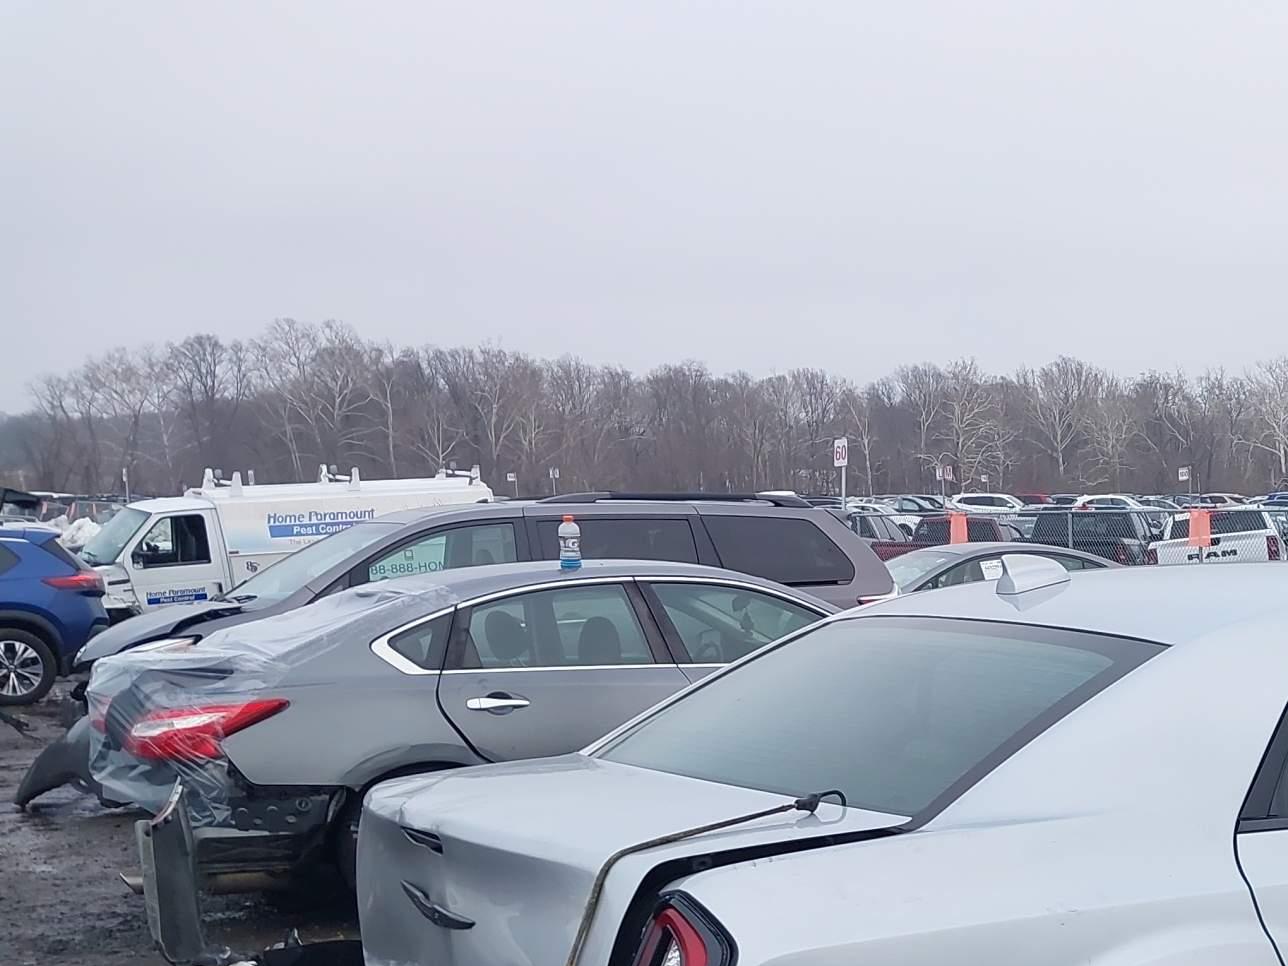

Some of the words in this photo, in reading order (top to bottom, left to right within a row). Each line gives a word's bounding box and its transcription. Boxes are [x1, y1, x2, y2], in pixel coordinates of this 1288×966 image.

[835, 445, 846, 461] 60
[267, 512, 305, 524] Home
[308, 508, 375, 523] Paramount
[293, 525, 317, 535] Pest
[1187, 549, 1238, 561] RAM
[146, 590, 167, 598] Home
[168, 587, 206, 597] Paramount
